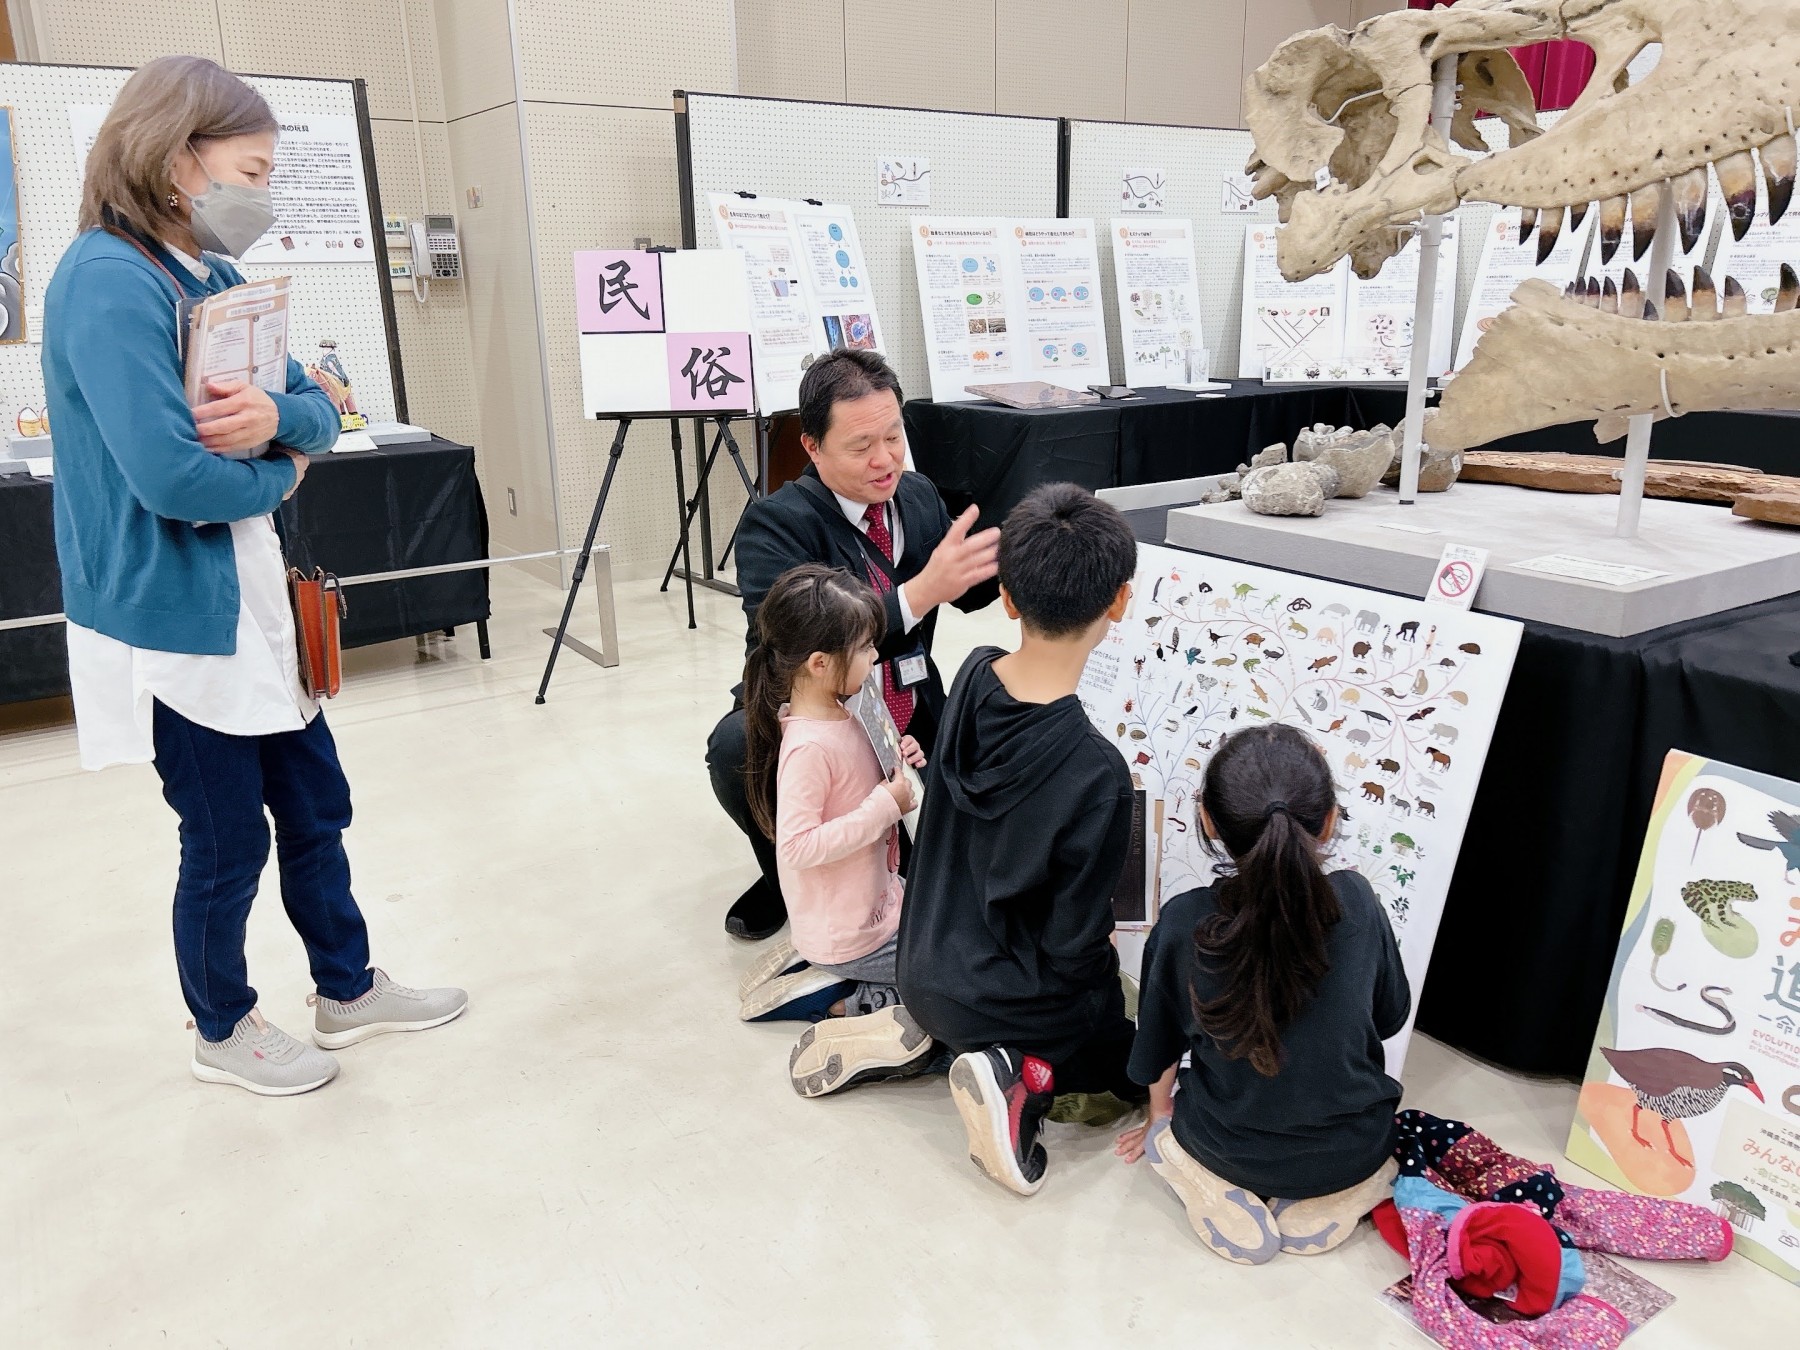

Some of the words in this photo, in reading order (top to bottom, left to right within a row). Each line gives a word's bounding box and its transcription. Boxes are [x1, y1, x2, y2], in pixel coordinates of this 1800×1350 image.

[386, 221, 401, 229] 故障
[392, 266, 407, 274] 故障
[598, 259, 651, 321] 民
[680, 346, 746, 401] 俗
